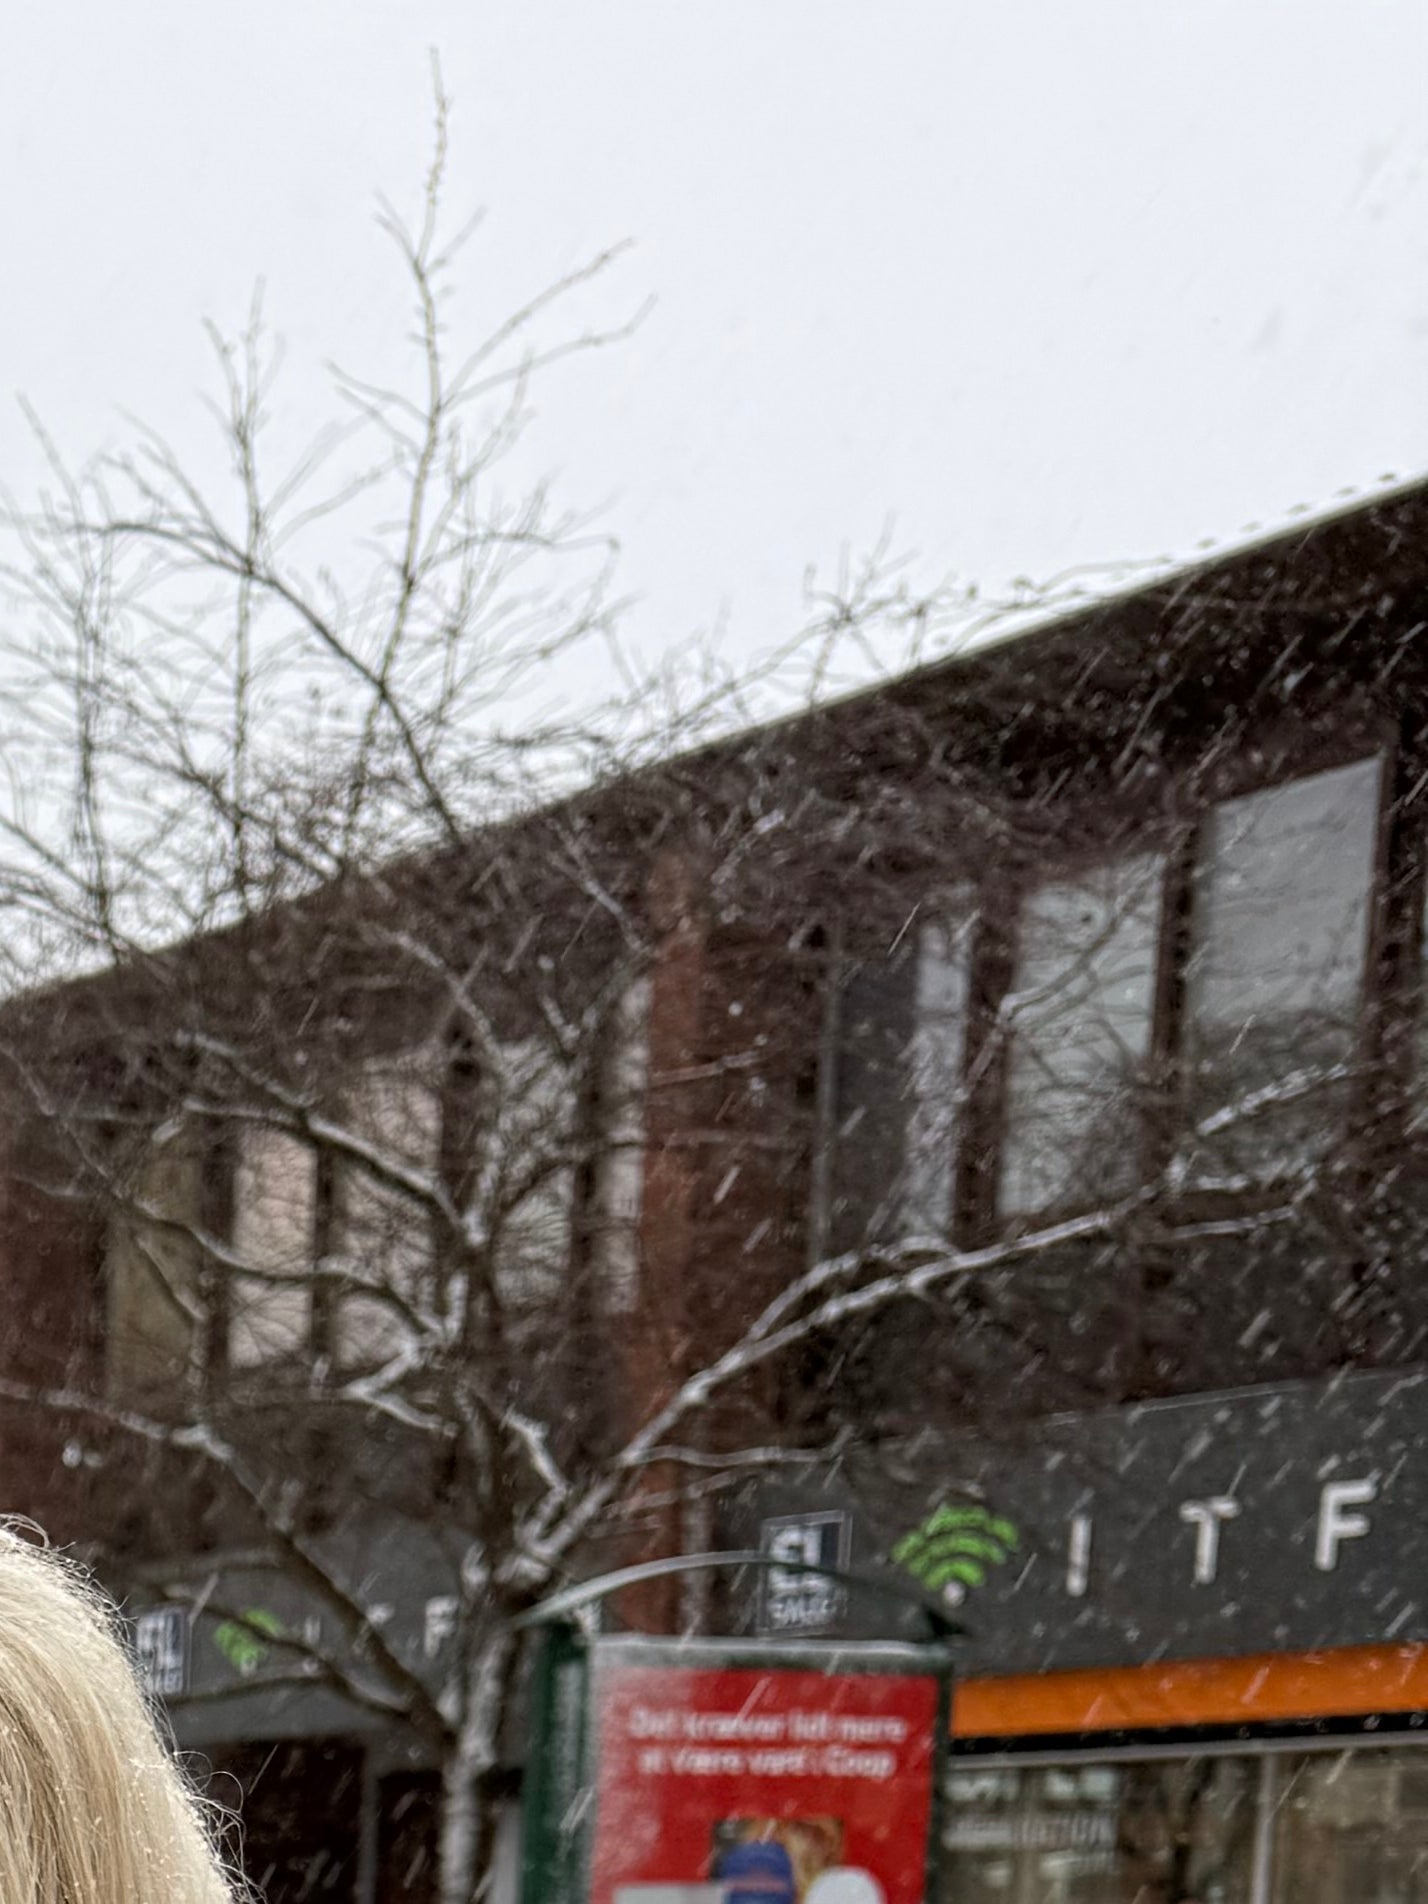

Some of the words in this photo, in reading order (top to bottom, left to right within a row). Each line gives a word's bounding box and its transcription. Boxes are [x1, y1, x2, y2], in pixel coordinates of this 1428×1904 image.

[628, 1707, 675, 1739] Det
[837, 1716, 908, 1743] mere
[823, 1745, 896, 1782] Coop
